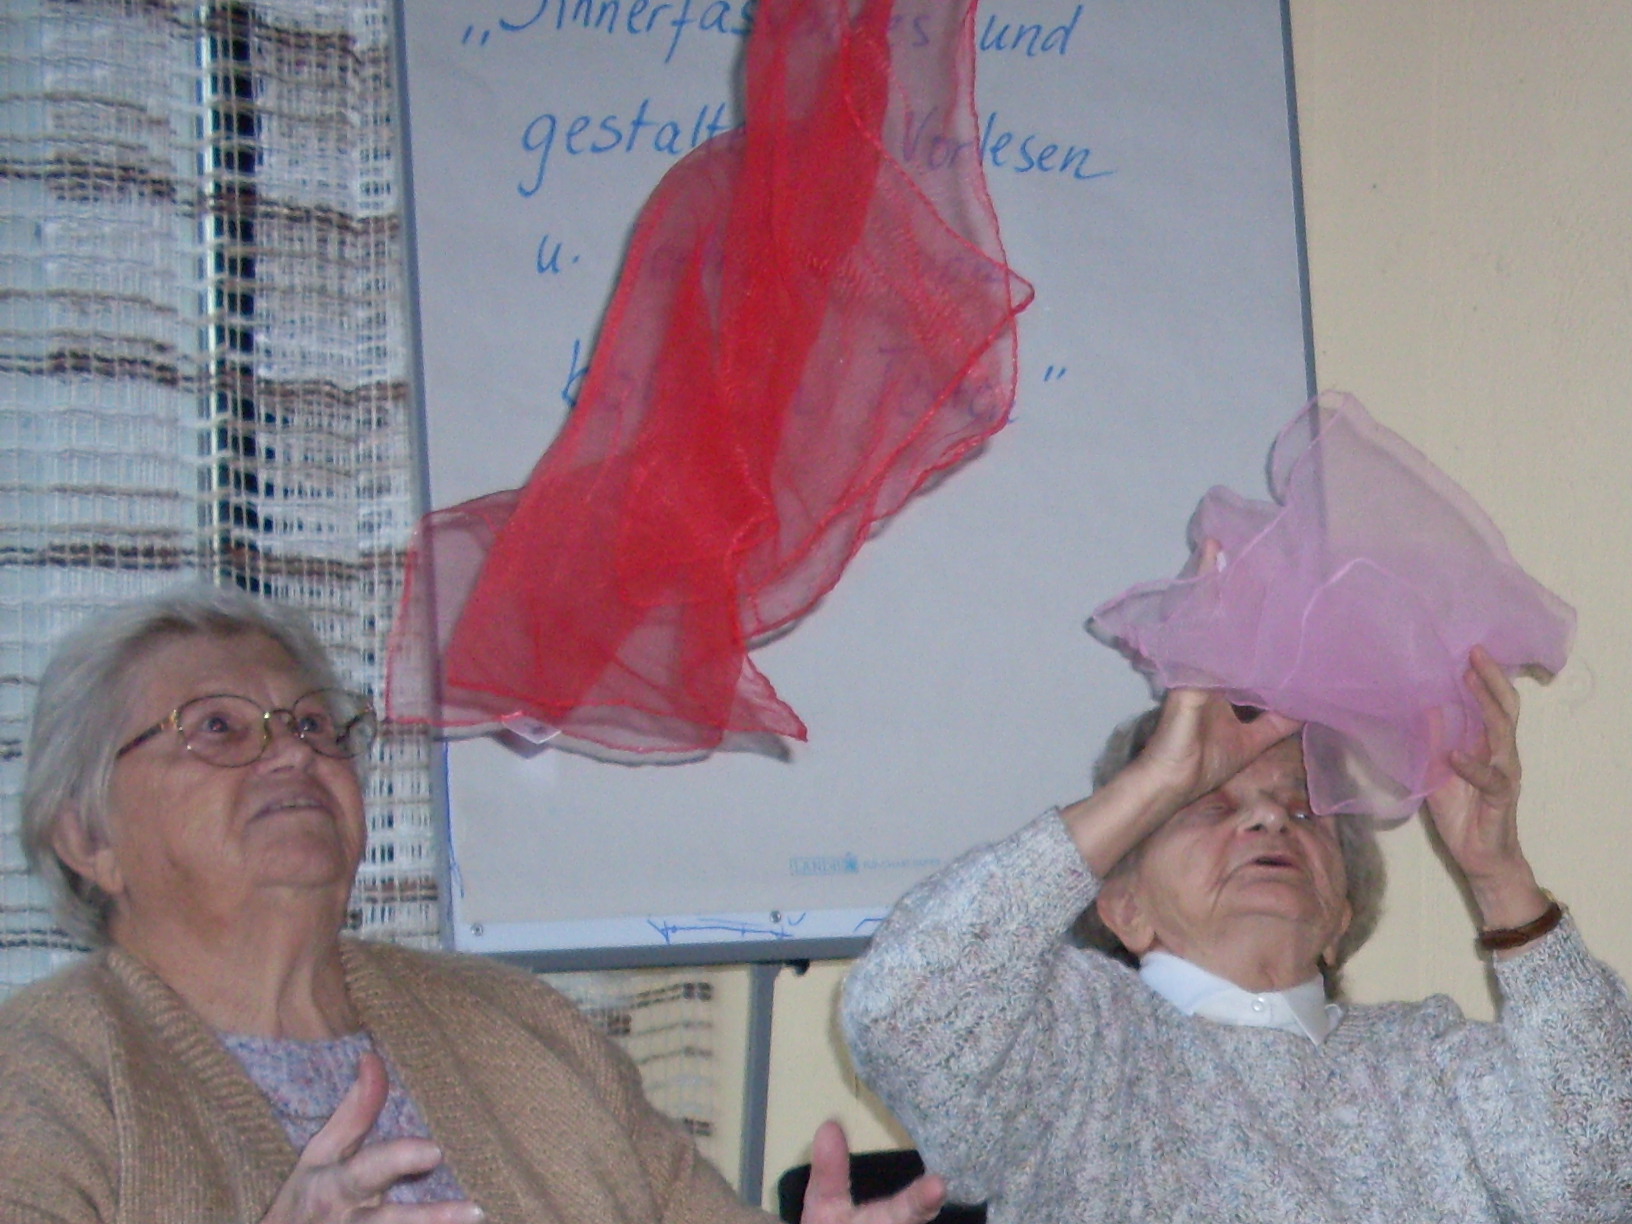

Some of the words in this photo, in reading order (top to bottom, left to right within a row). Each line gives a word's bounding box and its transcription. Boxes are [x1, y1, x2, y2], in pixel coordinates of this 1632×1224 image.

[979, 5, 1083, 57] und
[902, 107, 1114, 180] Vorlesen
[536, 234, 581, 274] u.
